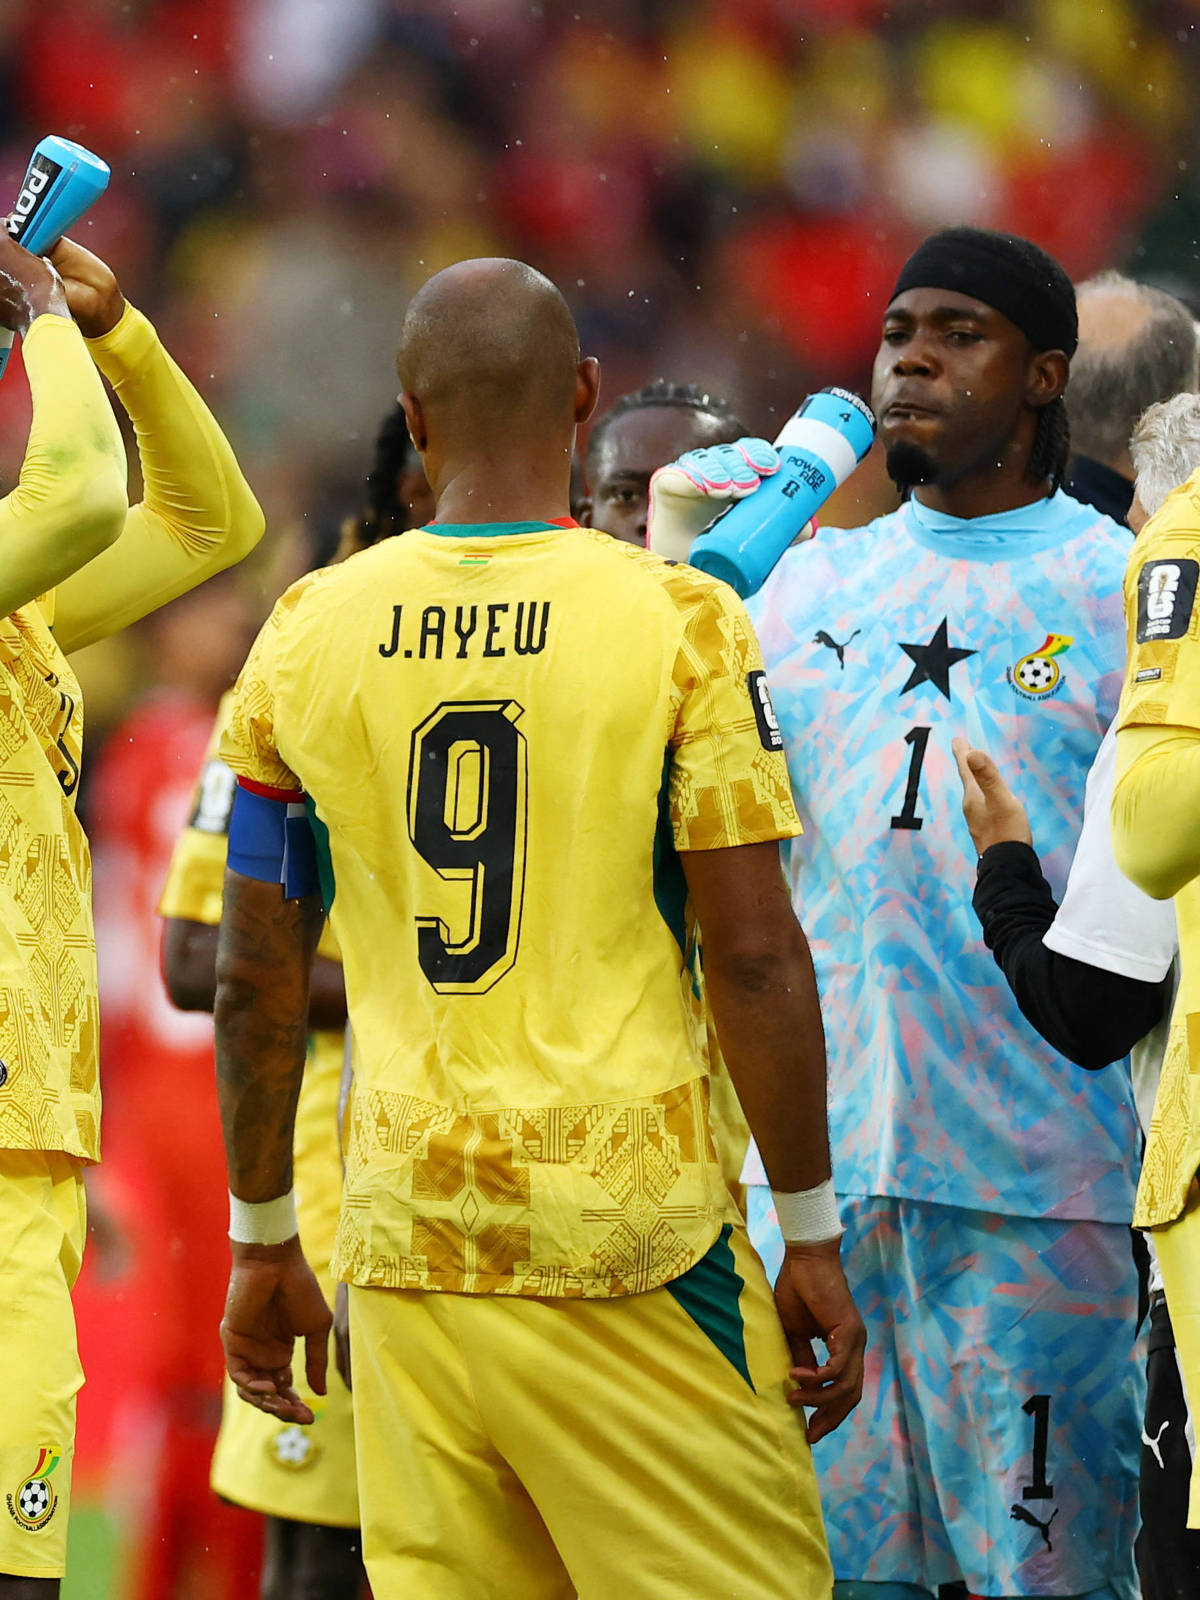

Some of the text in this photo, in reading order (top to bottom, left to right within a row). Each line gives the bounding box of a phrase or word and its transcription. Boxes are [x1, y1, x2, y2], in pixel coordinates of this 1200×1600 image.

[839, 412, 851, 422] 4
[786, 456, 826, 483] POWER
[379, 601, 550, 660] J.AYEW
[890, 726, 932, 830] 1
[406, 699, 528, 995] 9
[1022, 1395, 1054, 1500] 1
